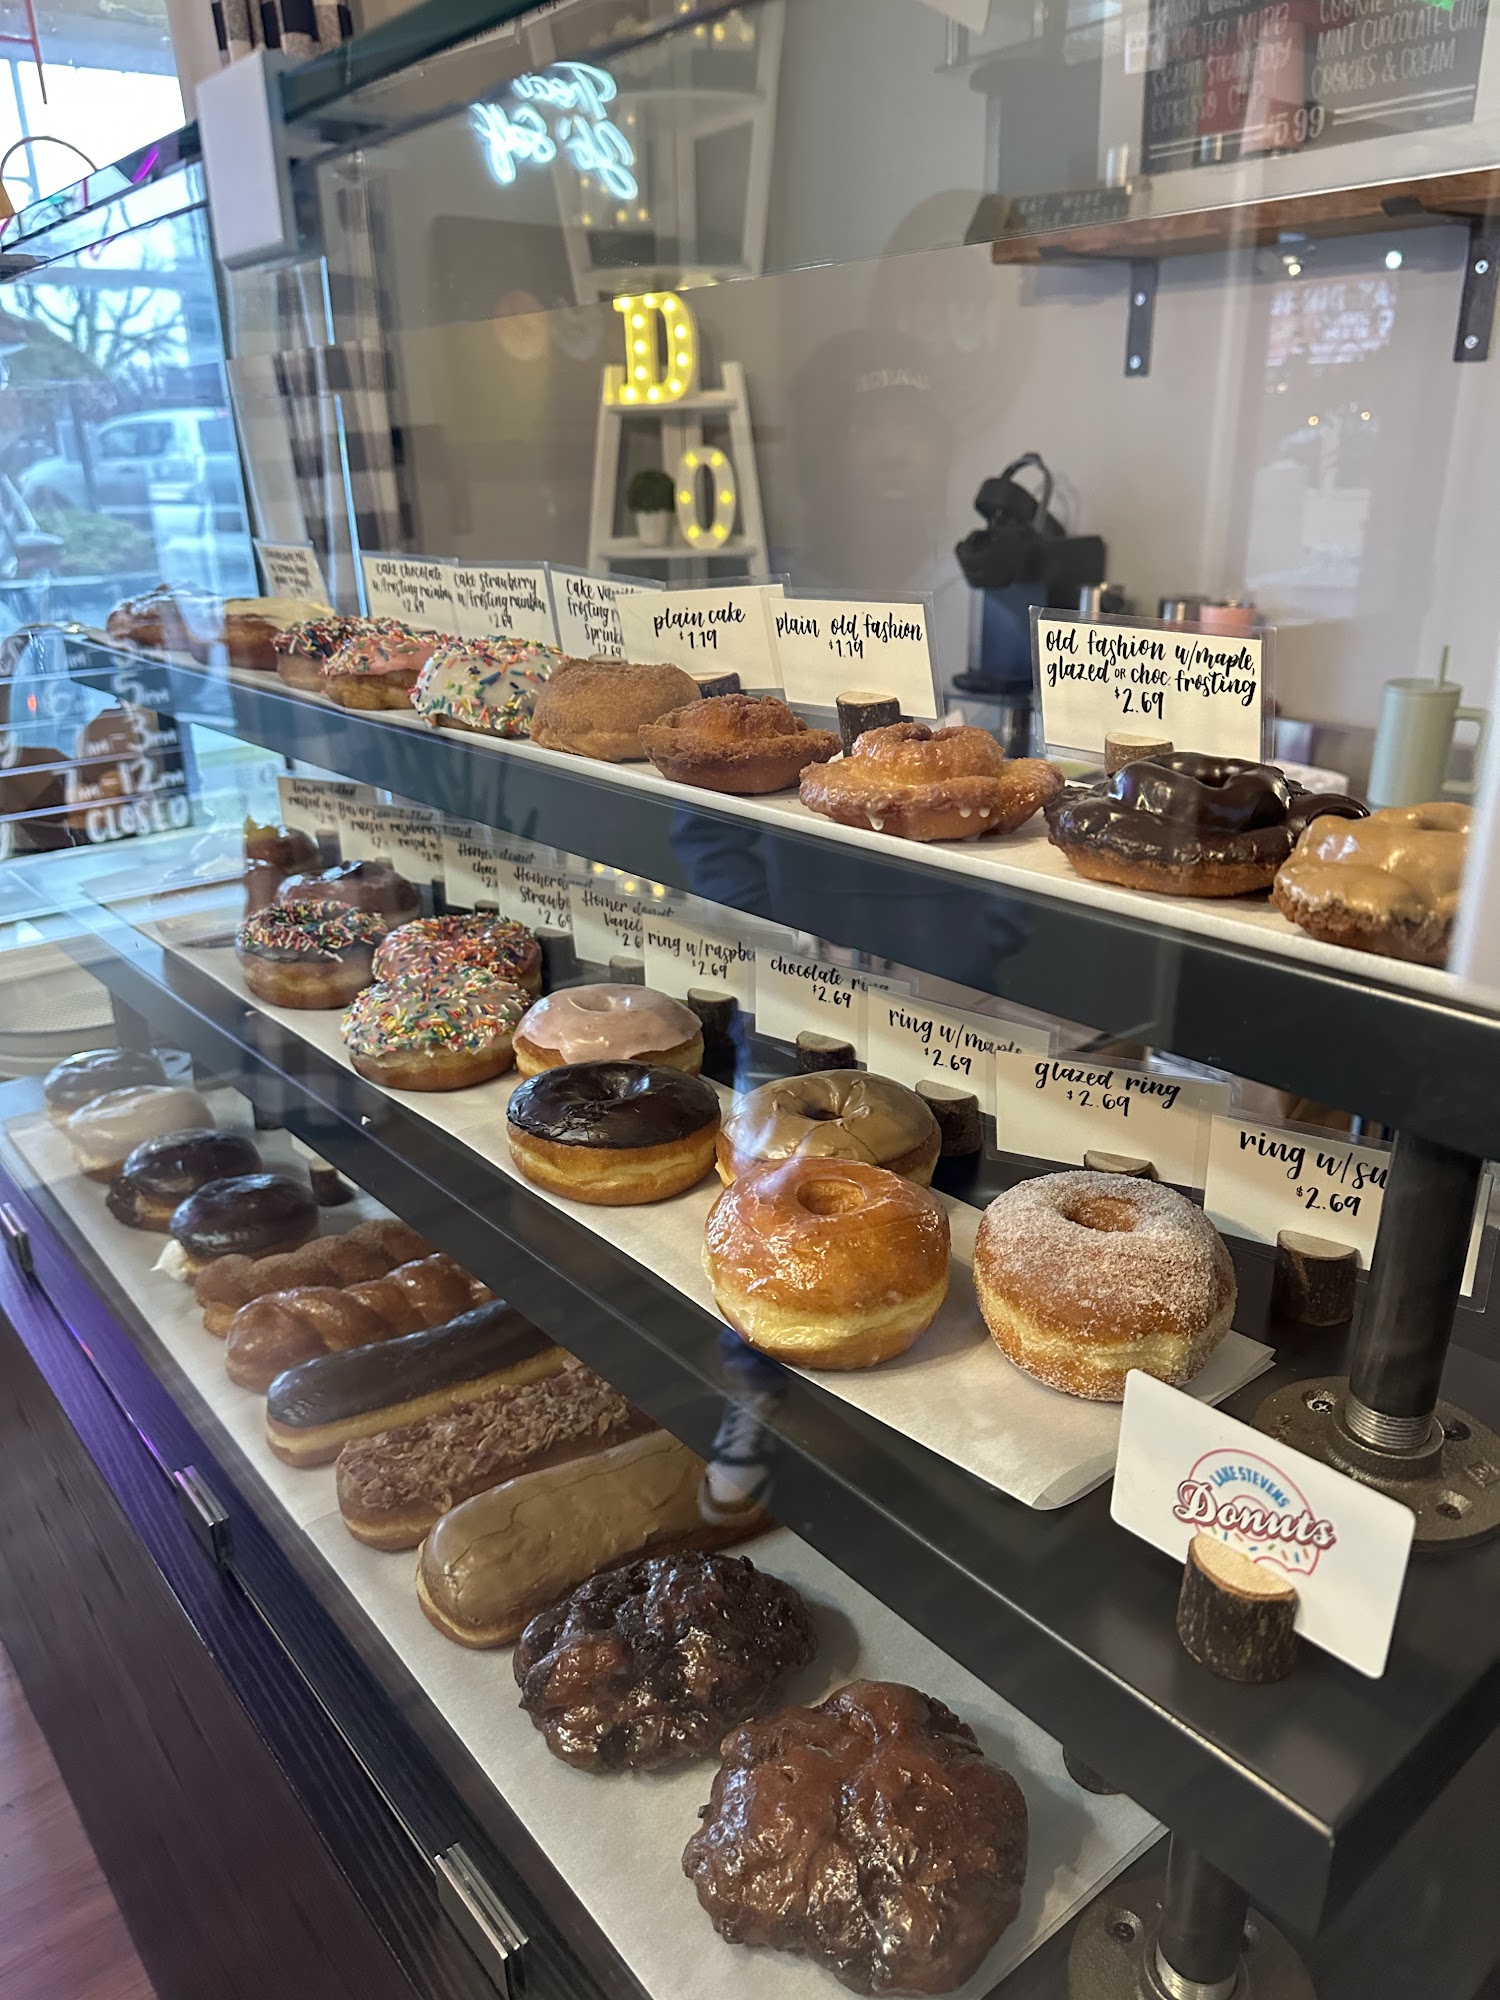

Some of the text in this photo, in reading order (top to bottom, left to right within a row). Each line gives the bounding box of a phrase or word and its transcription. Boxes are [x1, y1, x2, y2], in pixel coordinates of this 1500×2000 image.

[1317, 22, 1357, 62] MINT
[1361, 5, 1442, 50] CHOCOLATE
[1311, 37, 1457, 99] COOKIES & CREAM
[612, 290, 698, 405] D
[676, 446, 737, 552] O
[653, 607, 706, 638] plain
[708, 601, 746, 624] cake
[775, 611, 924, 643] plain old fashion
[679, 629, 718, 650] $1.19
[828, 636, 864, 660] $1.19
[1087, 630, 1167, 666] fashion
[1175, 640, 1257, 677] w/maple,
[1047, 655, 1257, 707] glazed OR choc. frosting
[1114, 686, 1165, 720] $2.69
[582, 889, 628, 913] Homer
[648, 930, 681, 957] ring
[692, 961, 728, 980] $2.69
[770, 955, 844, 986] chocolate
[812, 984, 852, 1009] $2.69
[888, 1007, 934, 1044] ring
[924, 1047, 973, 1076] $2.69
[1034, 1061, 1183, 1109] glazed ring
[1066, 1089, 1131, 1118] $2.69
[1240, 1130, 1307, 1180] ring
[1296, 1186, 1362, 1217] $2.69
[1209, 1465, 1291, 1508] LAKE STEVENS
[1172, 1479, 1338, 1550] Donuts
